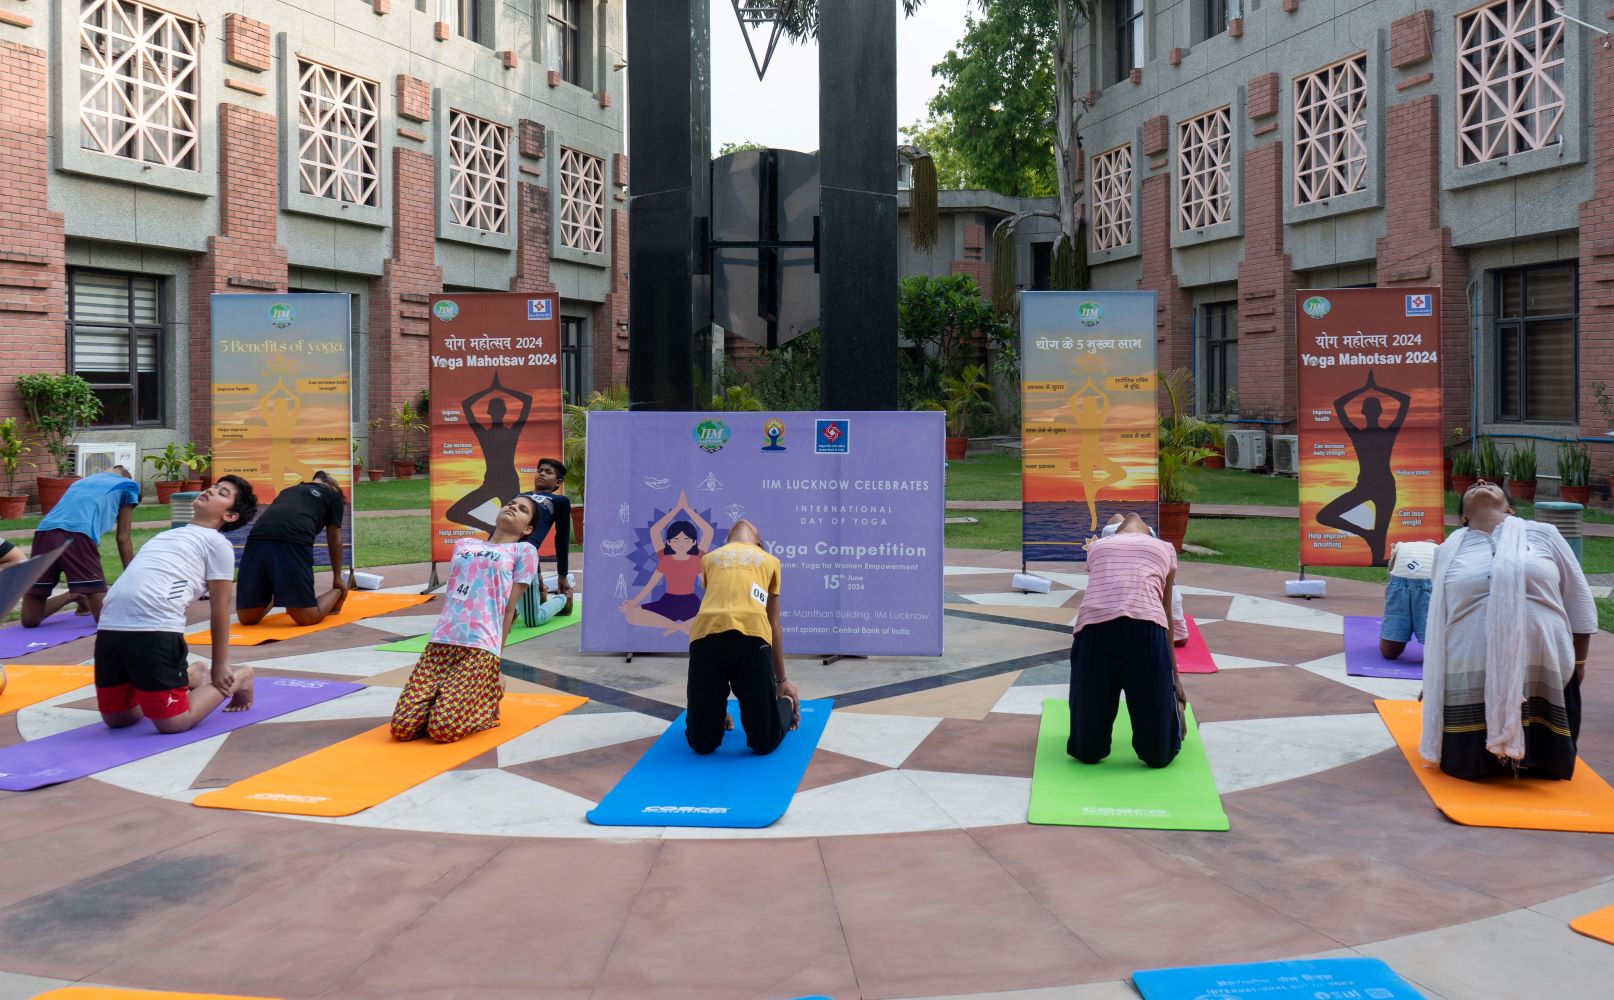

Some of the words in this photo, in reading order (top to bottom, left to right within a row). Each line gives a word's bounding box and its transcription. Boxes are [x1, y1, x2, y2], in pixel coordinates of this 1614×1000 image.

[444, 334, 466, 350] योग
[470, 334, 511, 350] महोत्सव
[515, 337, 543, 349] 2024
[1036, 337, 1059, 350] योग
[1062, 336, 1074, 349] के
[1077, 340, 1083, 350] 5
[1087, 339, 1115, 354] मुख्य
[1315, 332, 1338, 348] योग
[1343, 331, 1388, 348] महोत्सव
[1392, 334, 1422, 346] 2024
[220, 340, 228, 353] 5
[231, 339, 287, 353] Benefits
[290, 339, 304, 352] of
[432, 355, 463, 370] Yoga
[467, 354, 525, 367] Mahotsav
[528, 353, 557, 366] 2024
[1302, 353, 1335, 368] Yoga
[1339, 352, 1402, 366] Mahotsav
[1405, 351, 1438, 364] 2024
[701, 428, 723, 440] IIM
[762, 480, 781, 489] IIM
[787, 479, 849, 490] LUCKNOW
[855, 480, 929, 491] CELEBRATES
[795, 505, 893, 513] INTERNATIONAL
[854, 518, 887, 526] YOGA
[765, 541, 808, 559] Yoga
[815, 541, 926, 560] Competition
[1313, 541, 1342, 549] breathing
[801, 562, 820, 570] Yoga
[865, 563, 918, 571] Empowerment
[1407, 560, 1419, 570] 01
[456, 584, 470, 596] 44
[753, 588, 765, 602] 06
[793, 609, 833, 618] Manthan
[836, 609, 872, 620] Building,
[874, 610, 887, 619] IIM
[889, 610, 929, 620] Lucknow
[800, 626, 830, 634] sponsor:
[832, 626, 859, 634] Central
[861, 626, 880, 634] Bank
[891, 627, 911, 635] India
